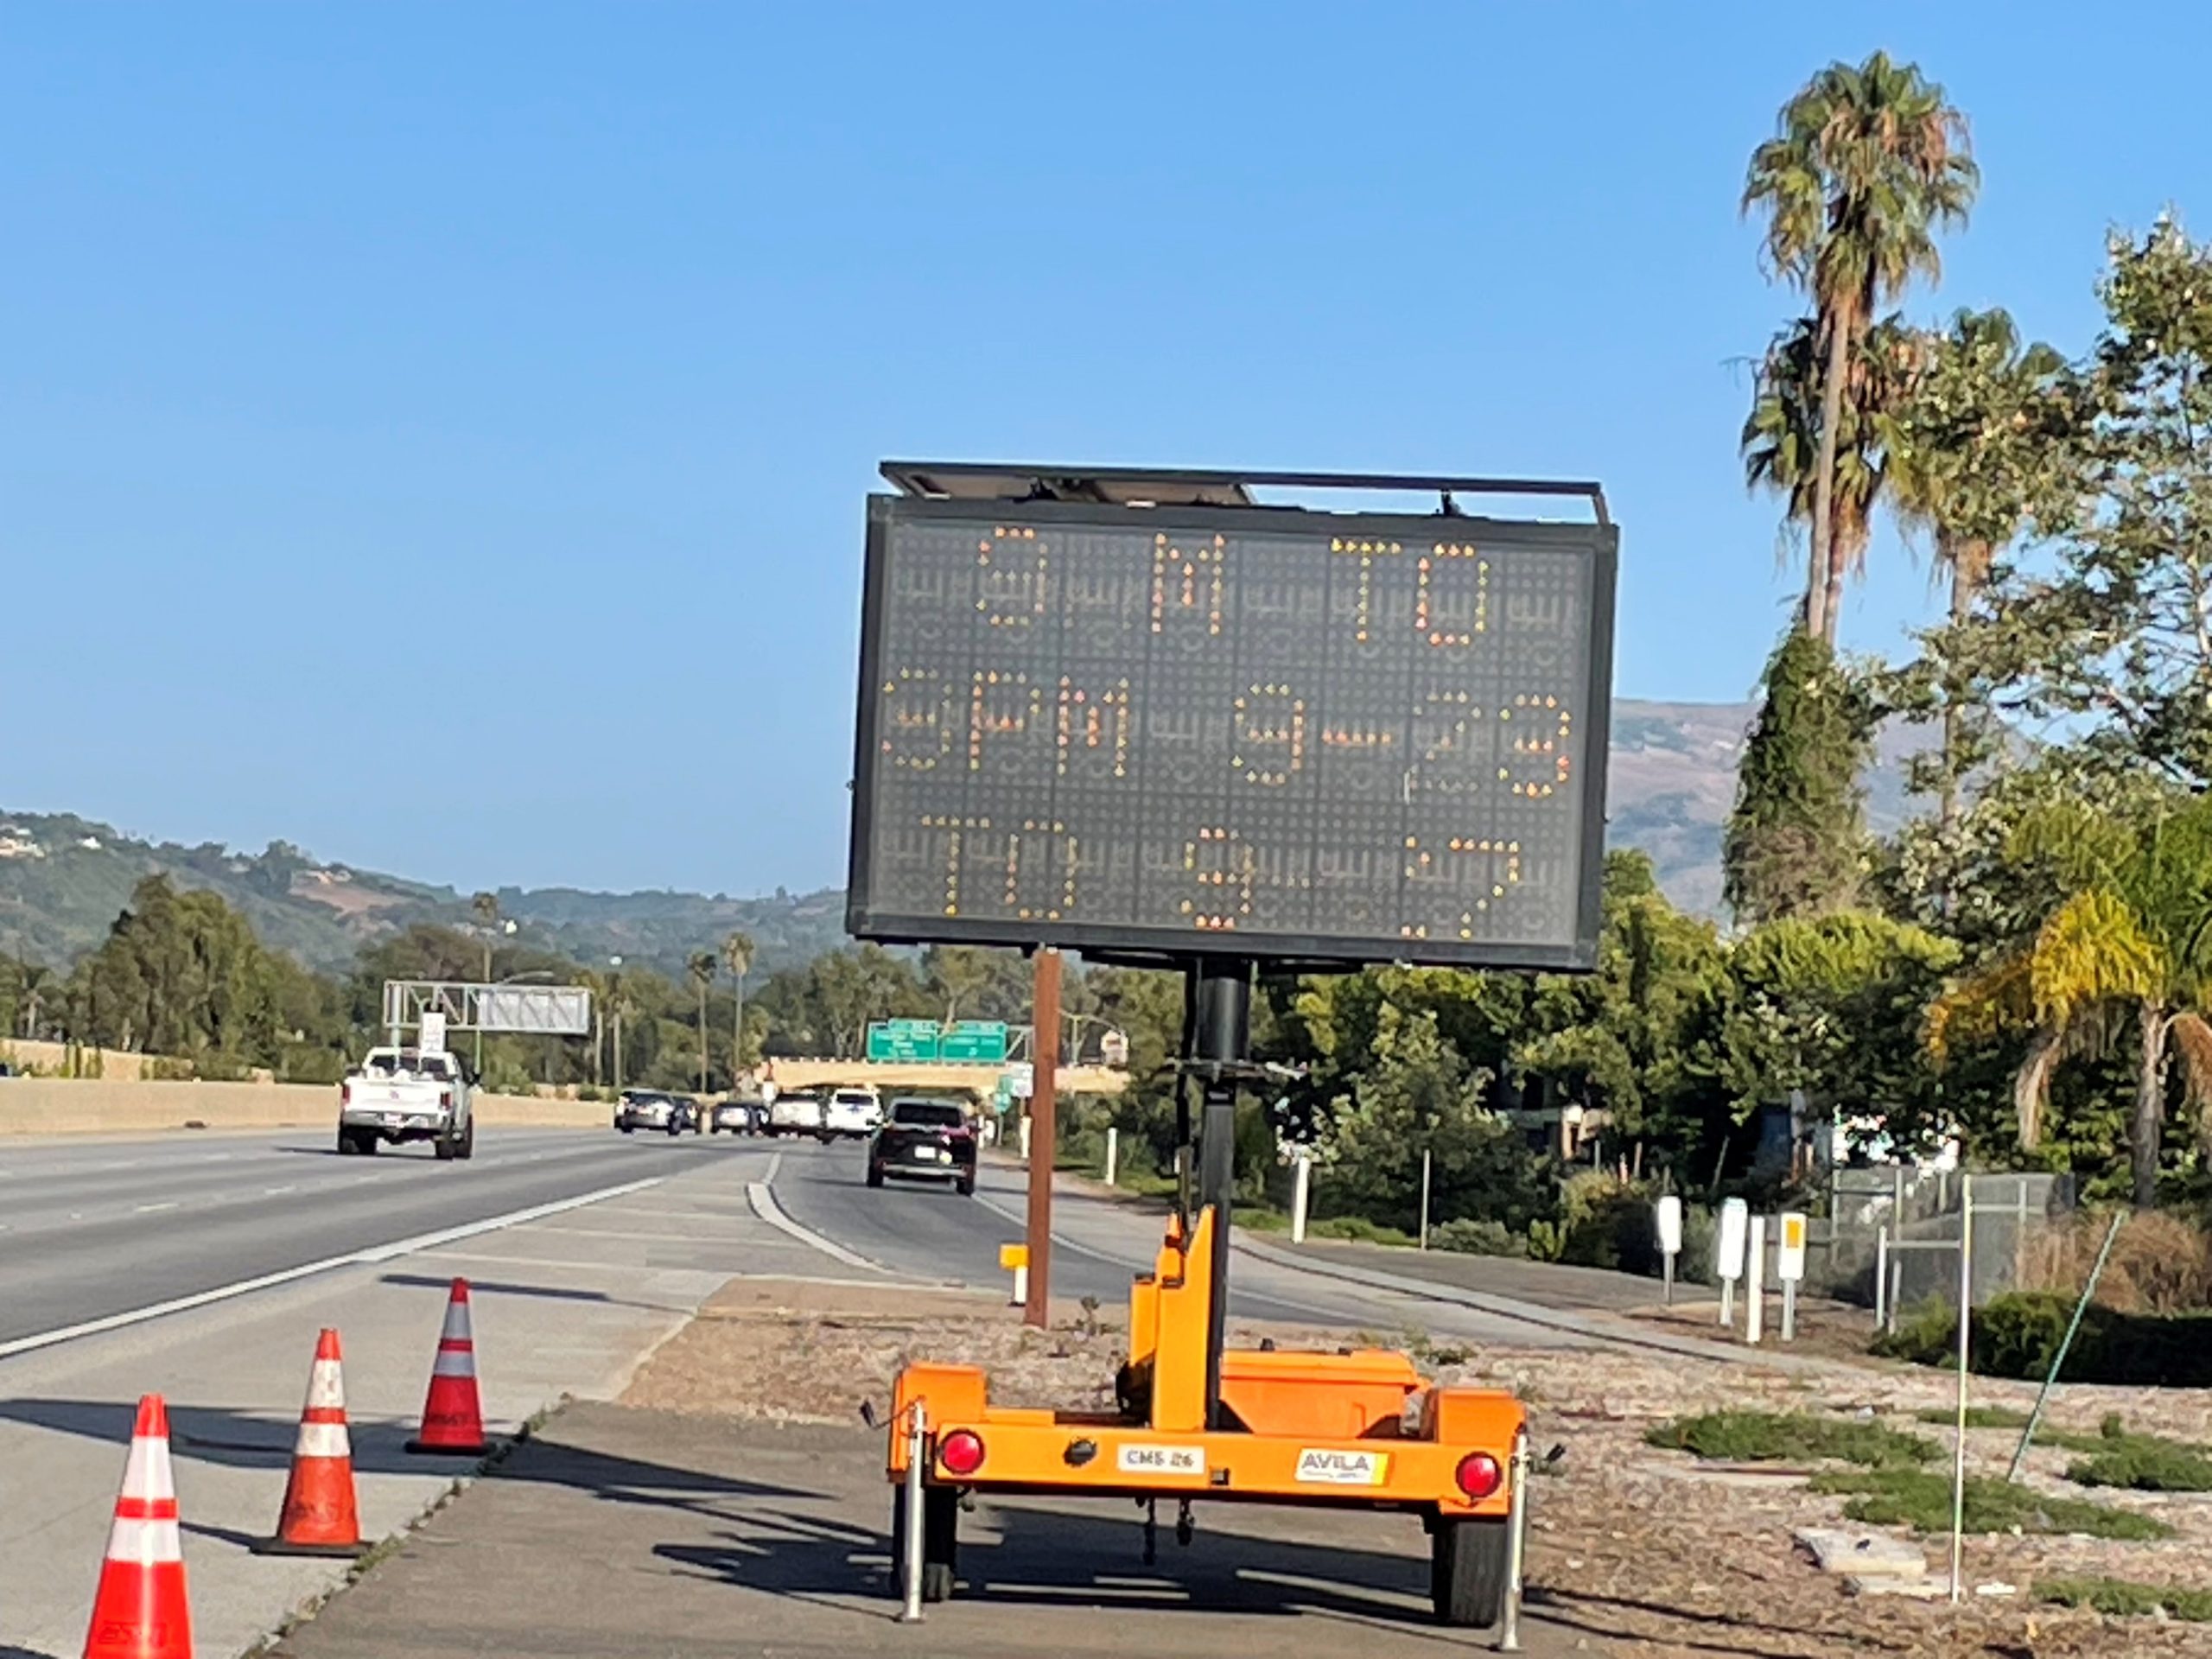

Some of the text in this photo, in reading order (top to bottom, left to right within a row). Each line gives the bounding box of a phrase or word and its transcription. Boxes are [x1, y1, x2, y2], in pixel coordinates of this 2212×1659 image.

[1331, 537, 1491, 647] TO
[919, 814, 1079, 921] TO
[1301, 1452, 1370, 1471] AVILA
